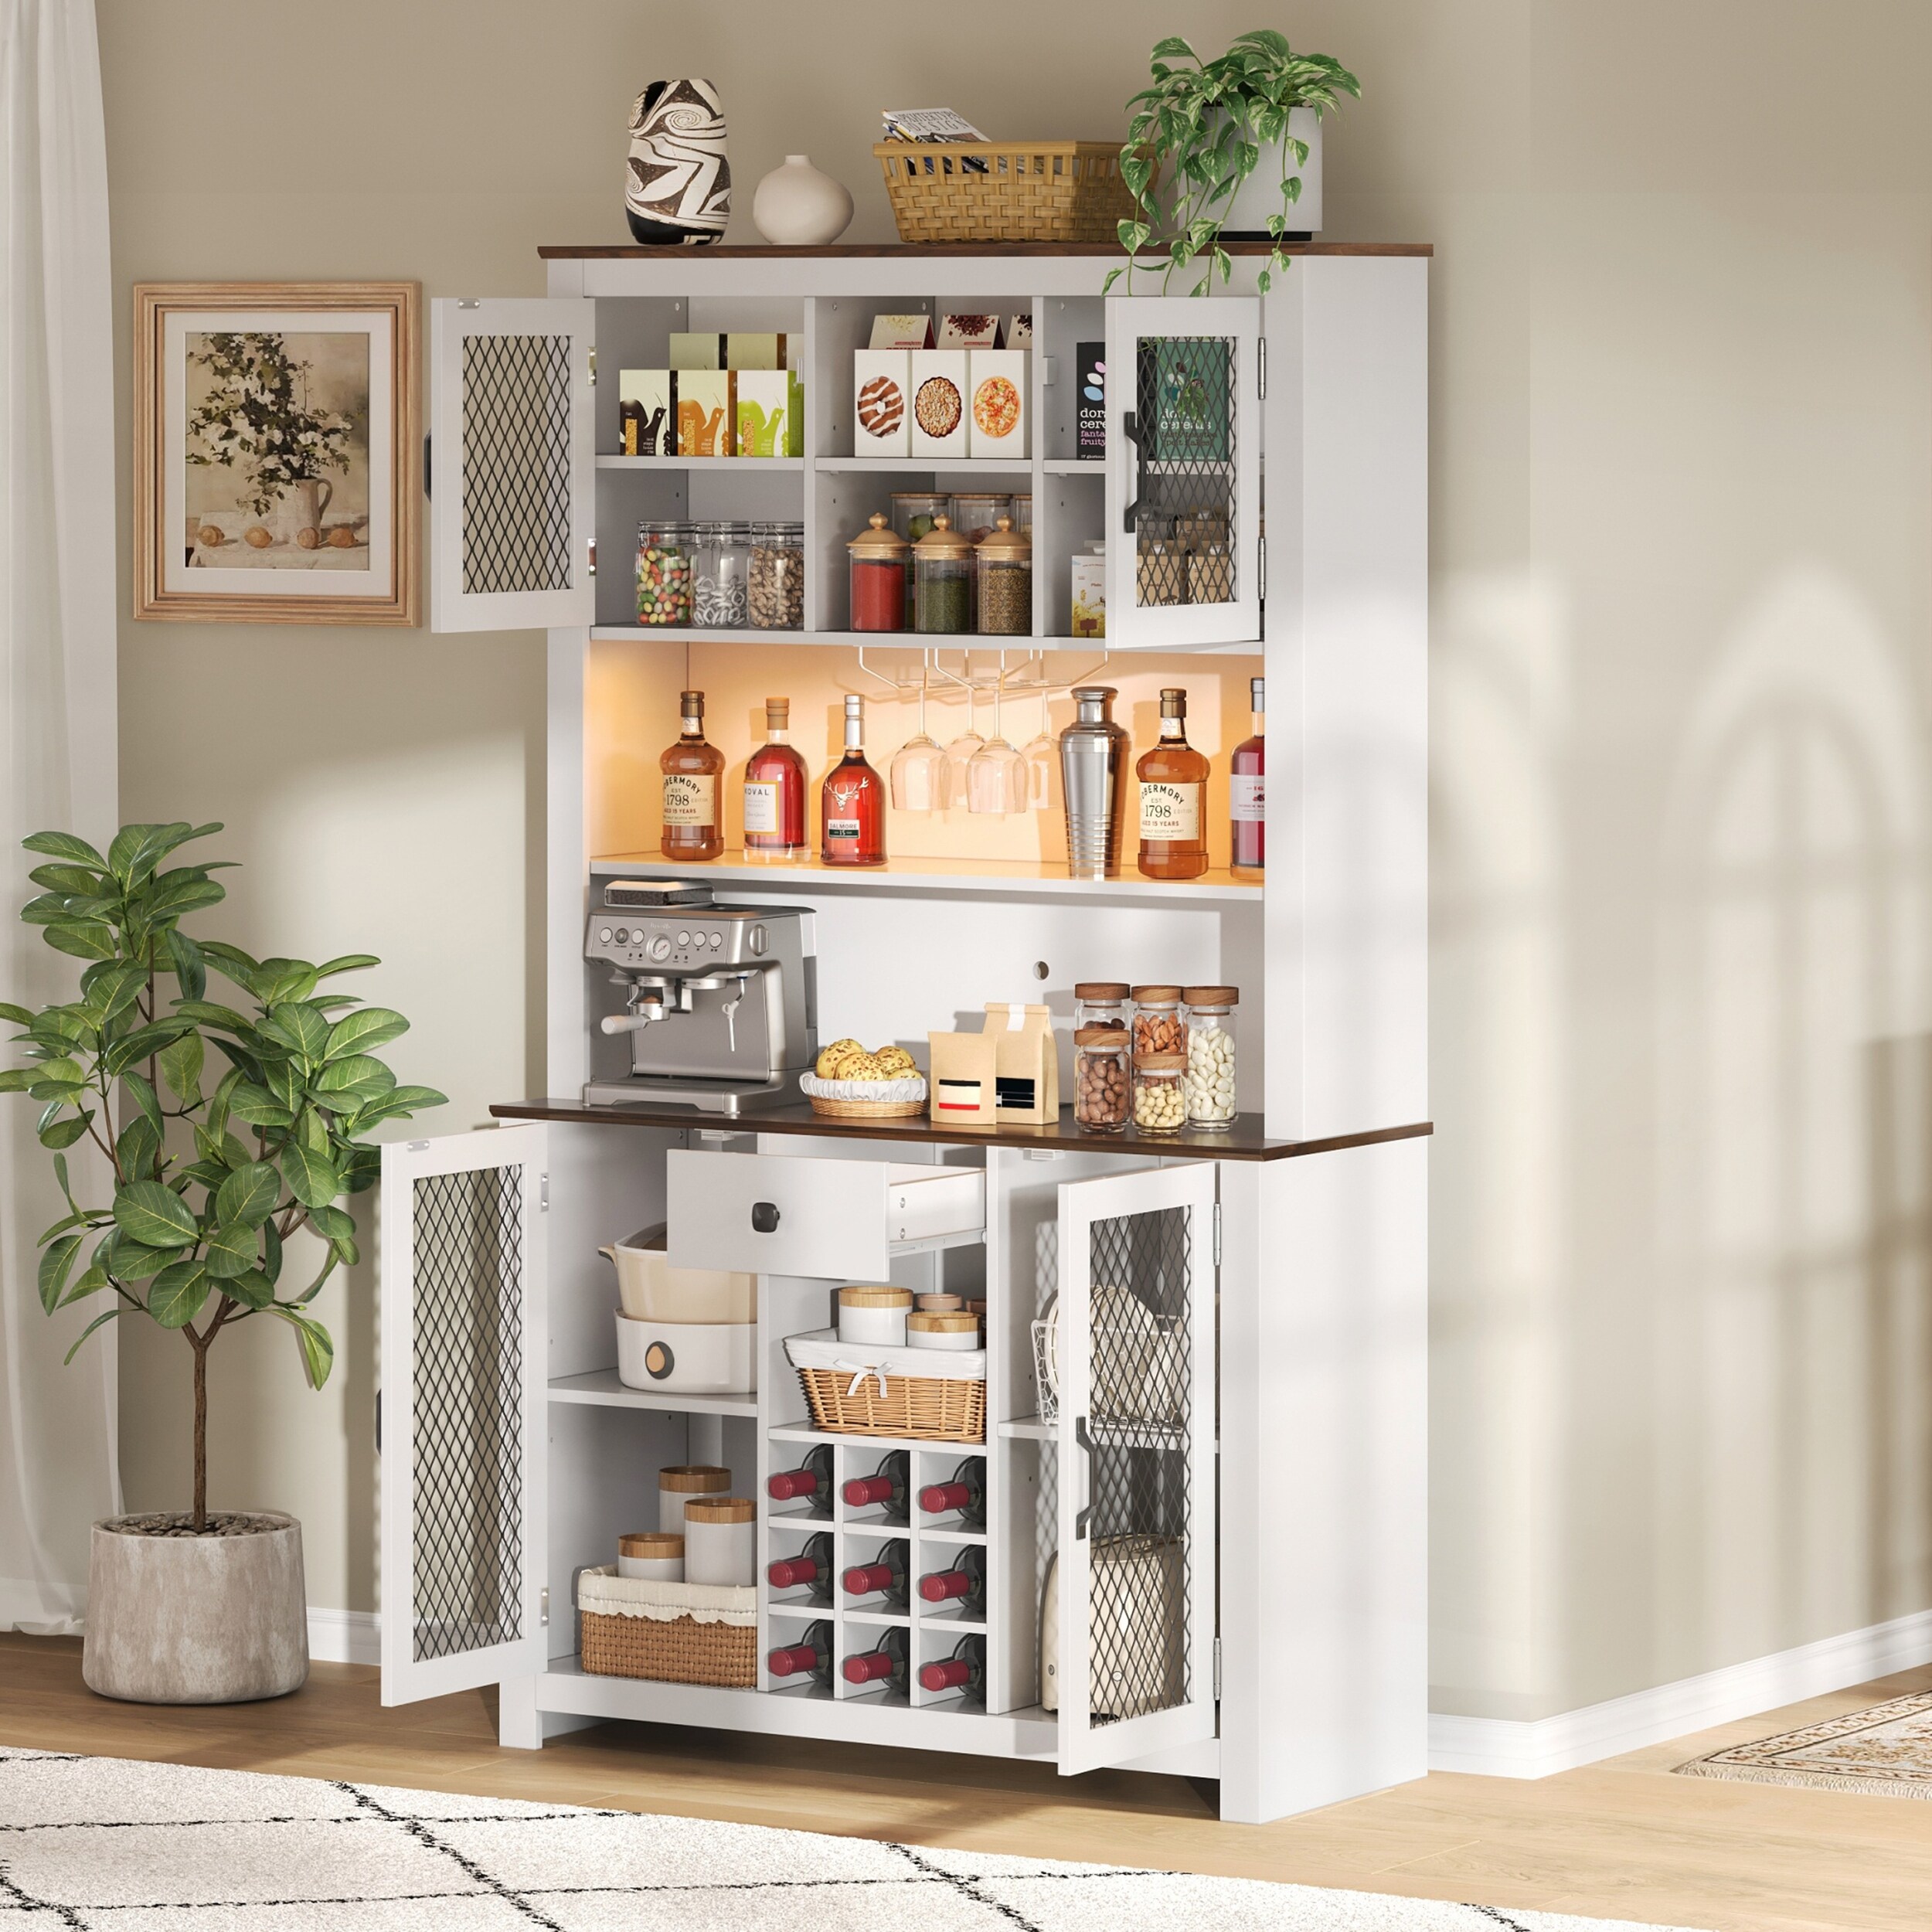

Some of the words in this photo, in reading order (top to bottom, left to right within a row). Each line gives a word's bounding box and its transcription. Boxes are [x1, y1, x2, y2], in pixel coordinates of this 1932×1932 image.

[907, 119, 970, 131] DESIGN
[1080, 438, 1105, 447] fruity
[666, 794, 690, 806] 1798
[1145, 804, 1172, 818] 1798
